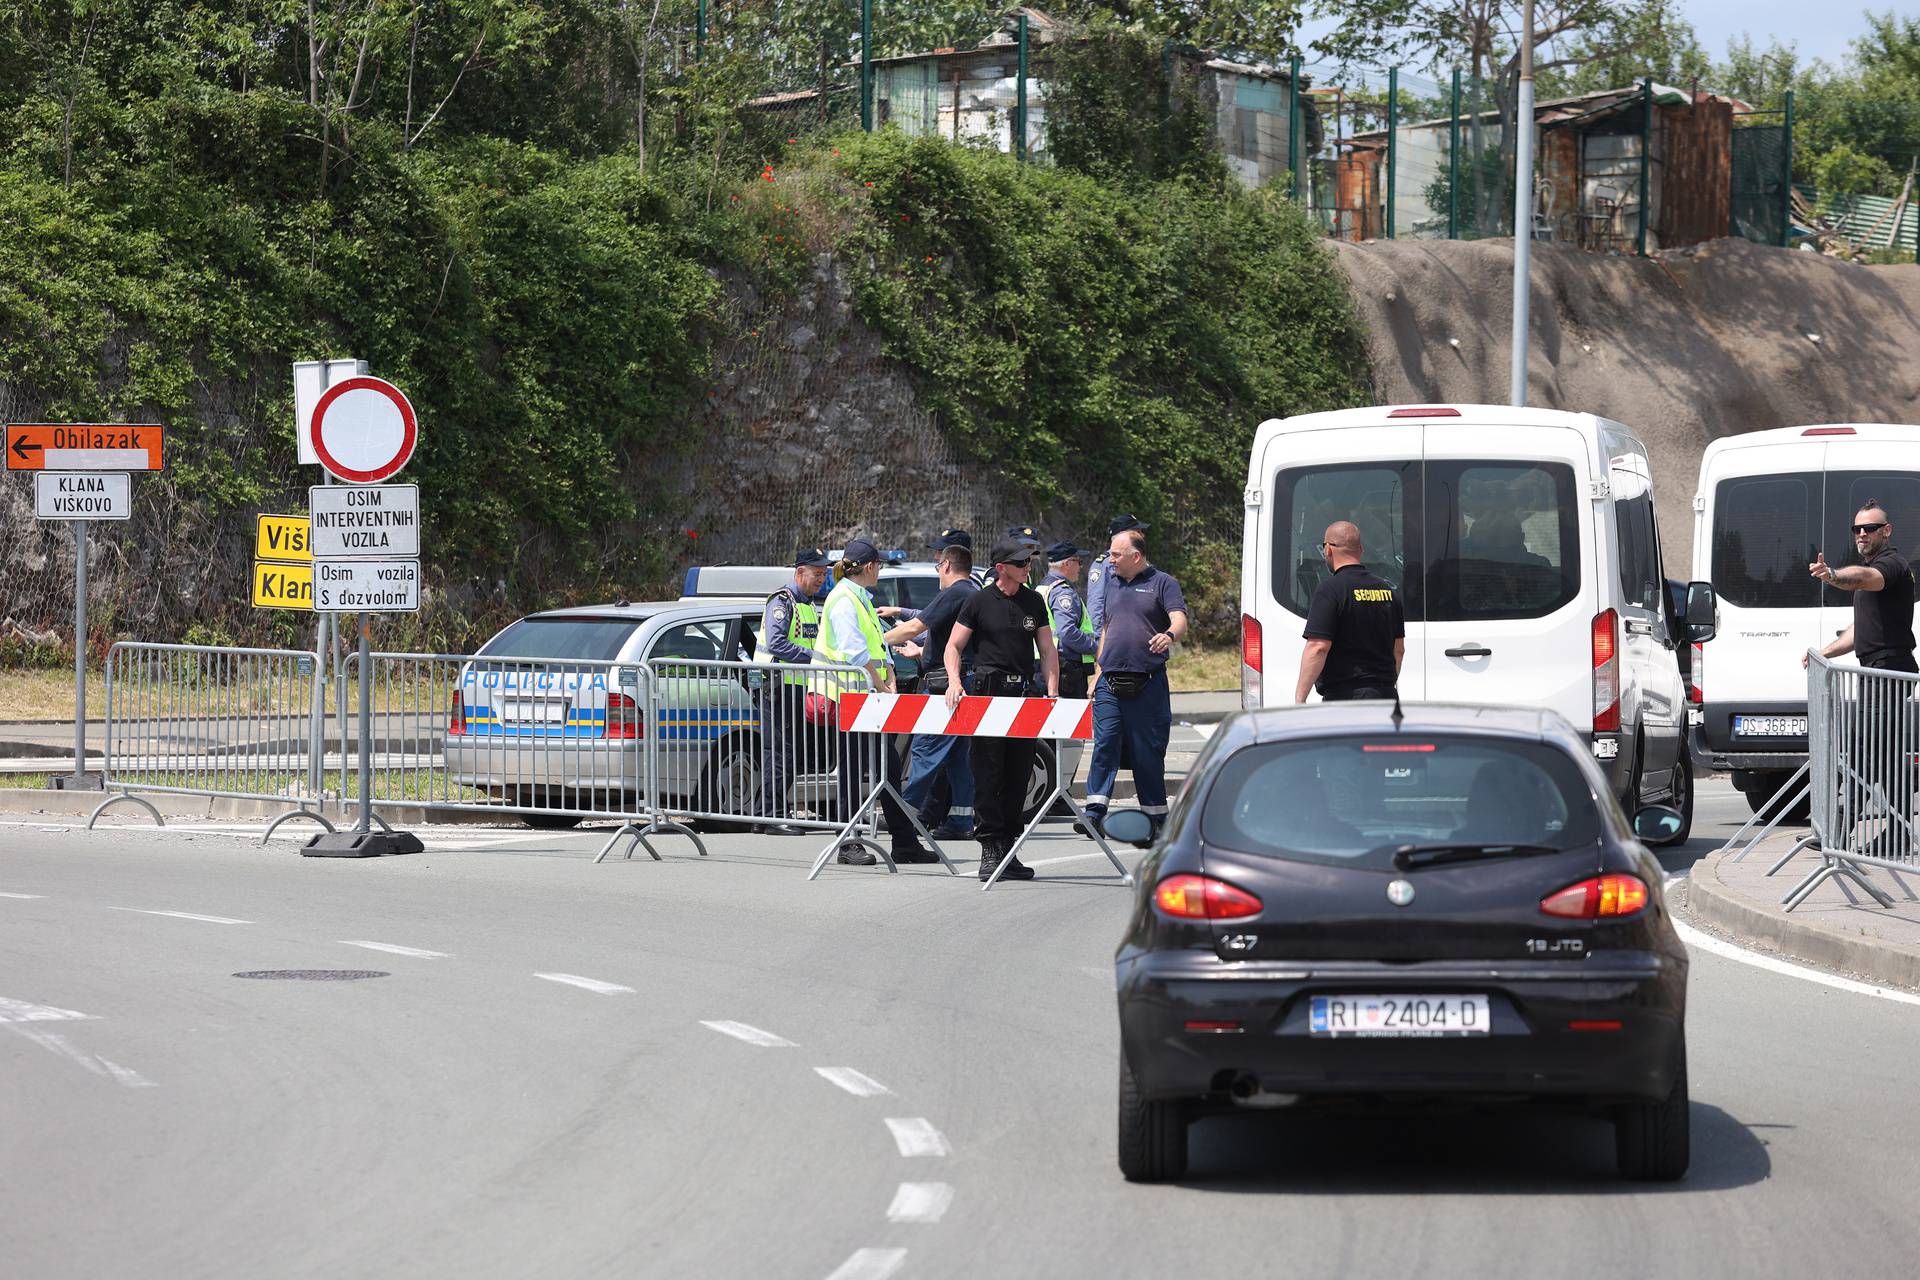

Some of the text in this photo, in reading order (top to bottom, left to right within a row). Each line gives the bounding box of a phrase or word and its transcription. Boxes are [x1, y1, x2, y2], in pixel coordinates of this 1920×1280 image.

[54, 428, 141, 449] Obilazak
[59, 478, 105, 492] KLANA
[54, 495, 112, 512] VIŠKOVO
[347, 490, 382, 506] OSIM
[316, 511, 414, 527] INTERVENTNIH
[267, 525, 310, 551] Viš
[342, 532, 389, 548] VOZILA
[321, 565, 414, 581] Osim vozila
[321, 590, 407, 605] S dozvolom
[1354, 589, 1393, 601] SECURITY
[463, 671, 606, 690] POLICIJA
[1743, 719, 1756, 731] OS
[1221, 935, 1258, 951] 147
[1549, 939, 1583, 951] JTD
[1331, 1000, 1476, 1027] RI 2404-D
